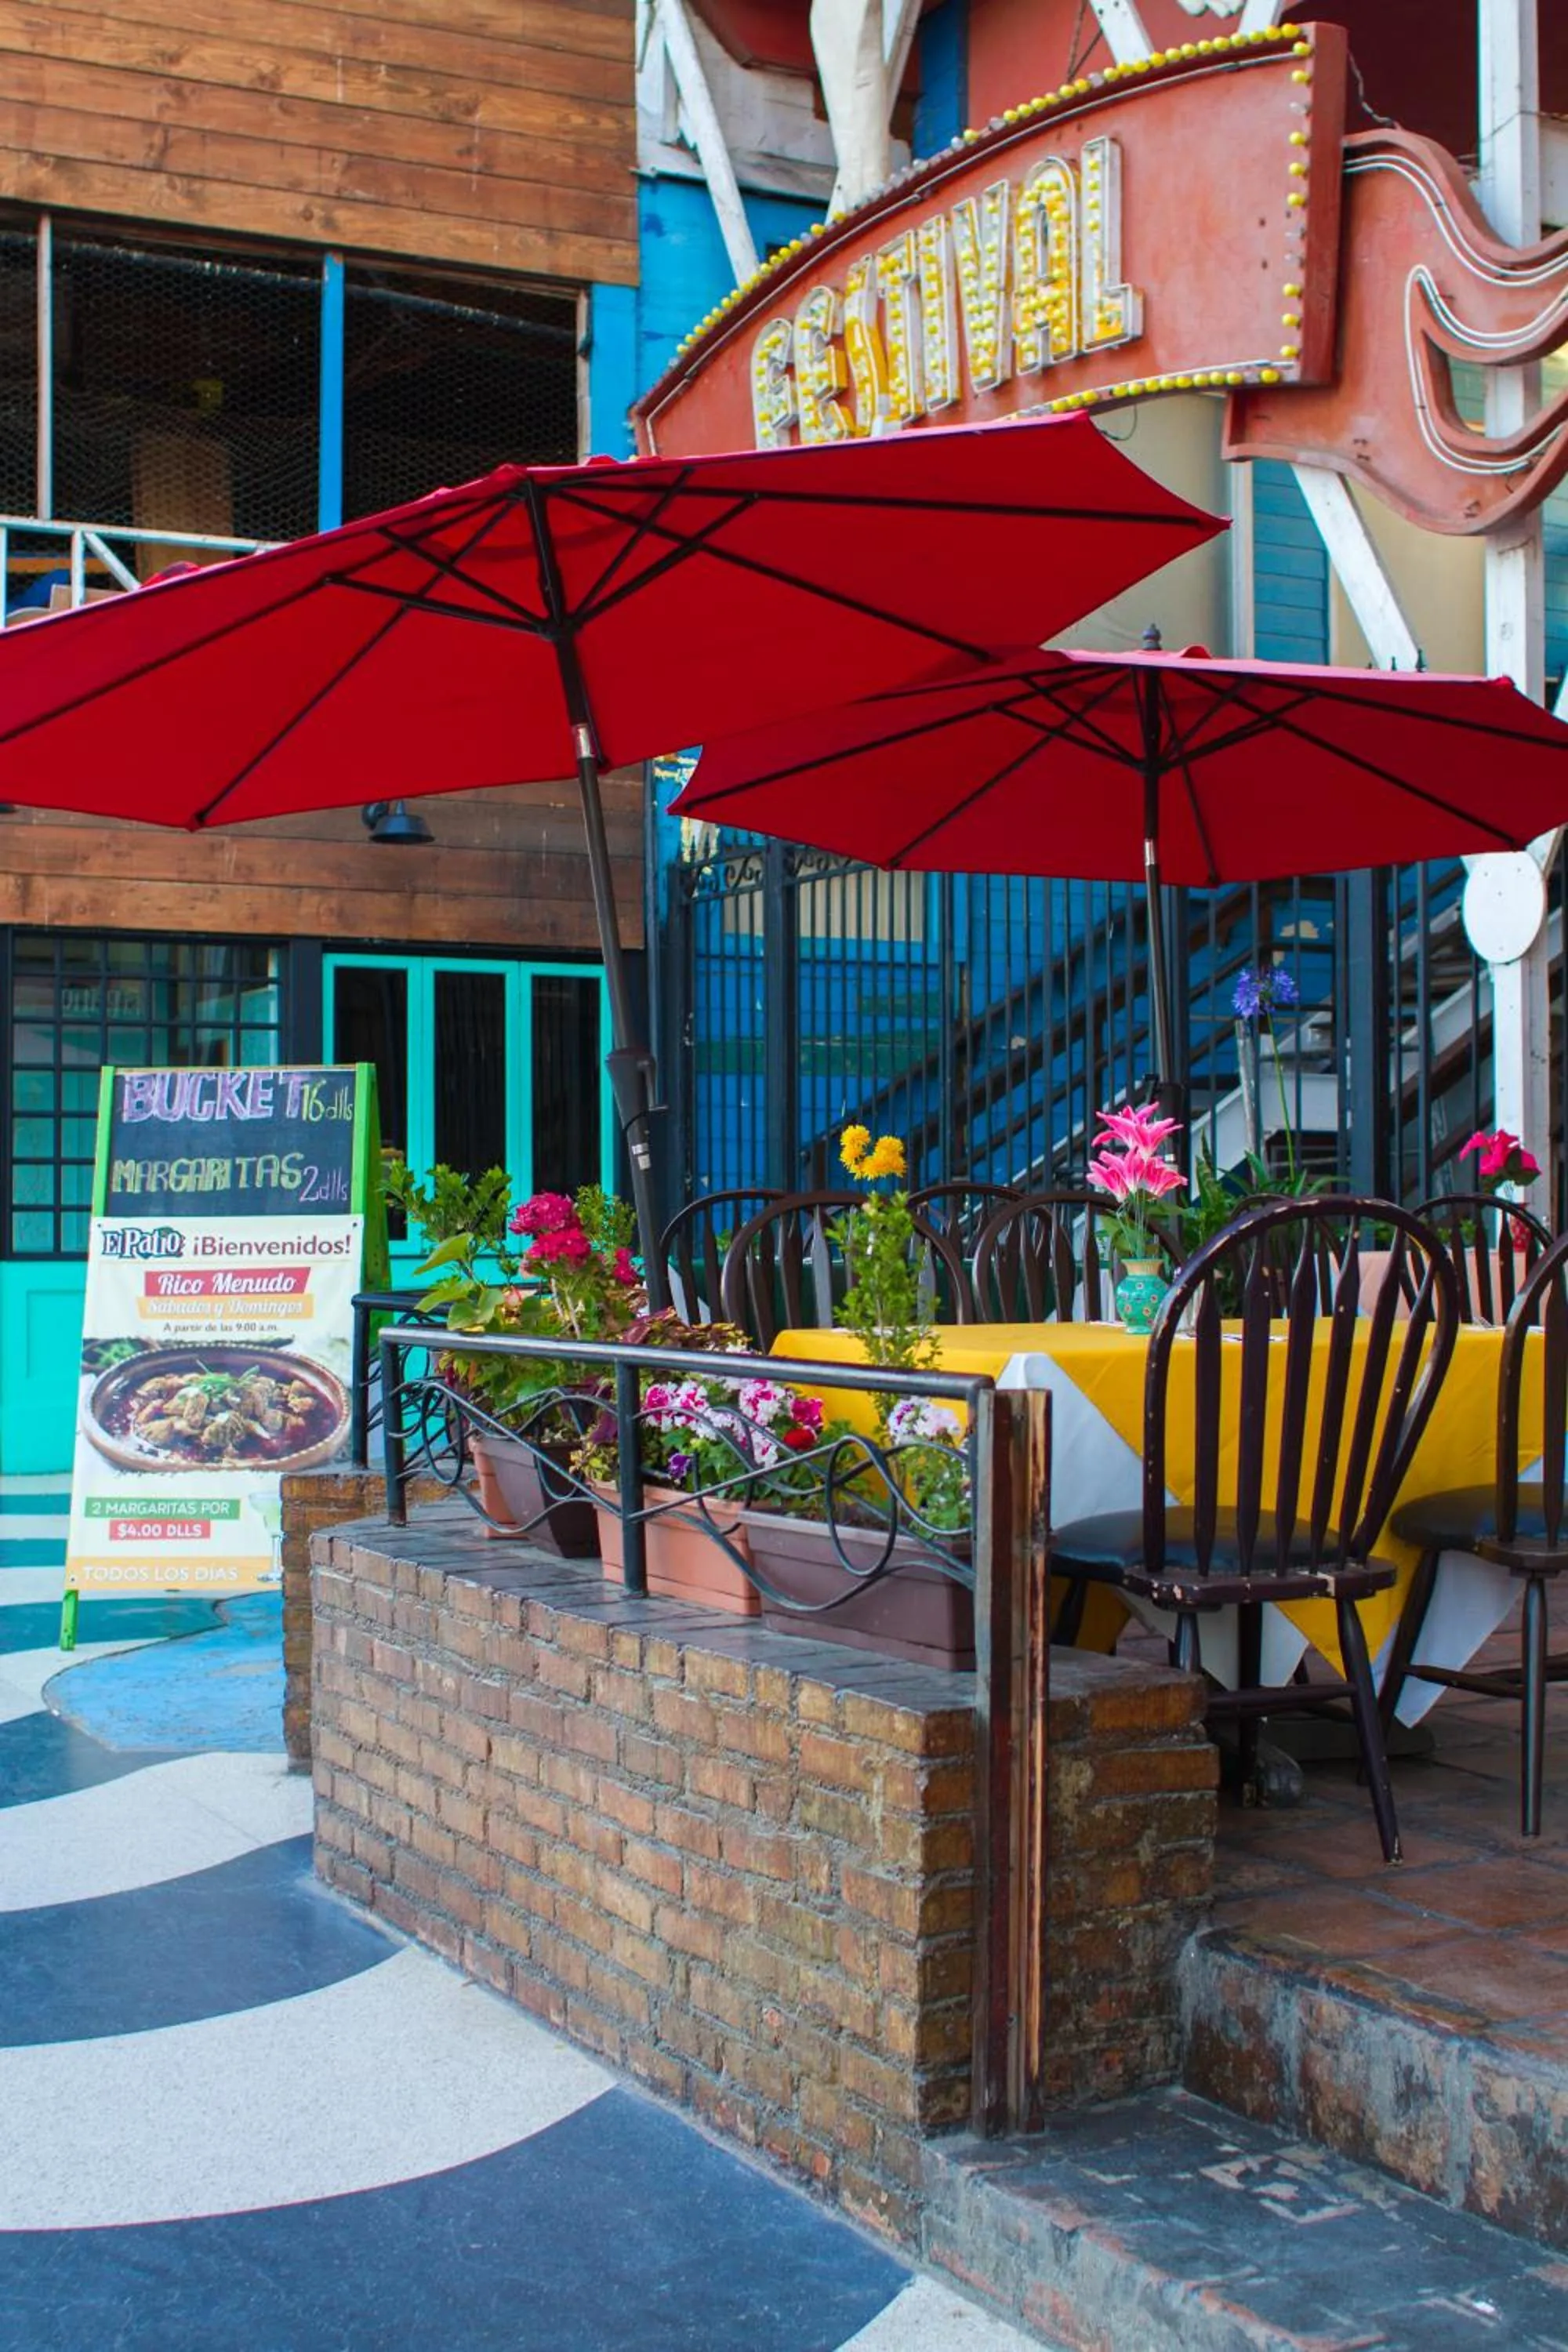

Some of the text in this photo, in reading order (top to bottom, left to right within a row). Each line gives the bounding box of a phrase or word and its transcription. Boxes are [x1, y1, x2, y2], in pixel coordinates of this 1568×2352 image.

[750, 135, 1143, 452] FESTIVAL
[123, 1071, 304, 1123] BUCKET
[112, 1152, 304, 1193] MARGARITAS
[299, 1165, 319, 1203] 2
[122, 1229, 181, 1257] Patio
[193, 1234, 351, 1255] ¡Bienvenidos!
[158, 1269, 296, 1295] Rico Menudo
[213, 1302, 223, 1320] y
[228, 1298, 303, 1318] Domingos
[163, 1323, 172, 1331] A
[174, 1323, 202, 1333] partir
[205, 1323, 217, 1331] de
[220, 1323, 233, 1331] las
[92, 1501, 230, 1515] 2 MARGARITAS POR
[117, 1523, 202, 1537] $4.00 DLLS
[82, 1566, 149, 1581] TODOS
[154, 1566, 189, 1581] LOS
